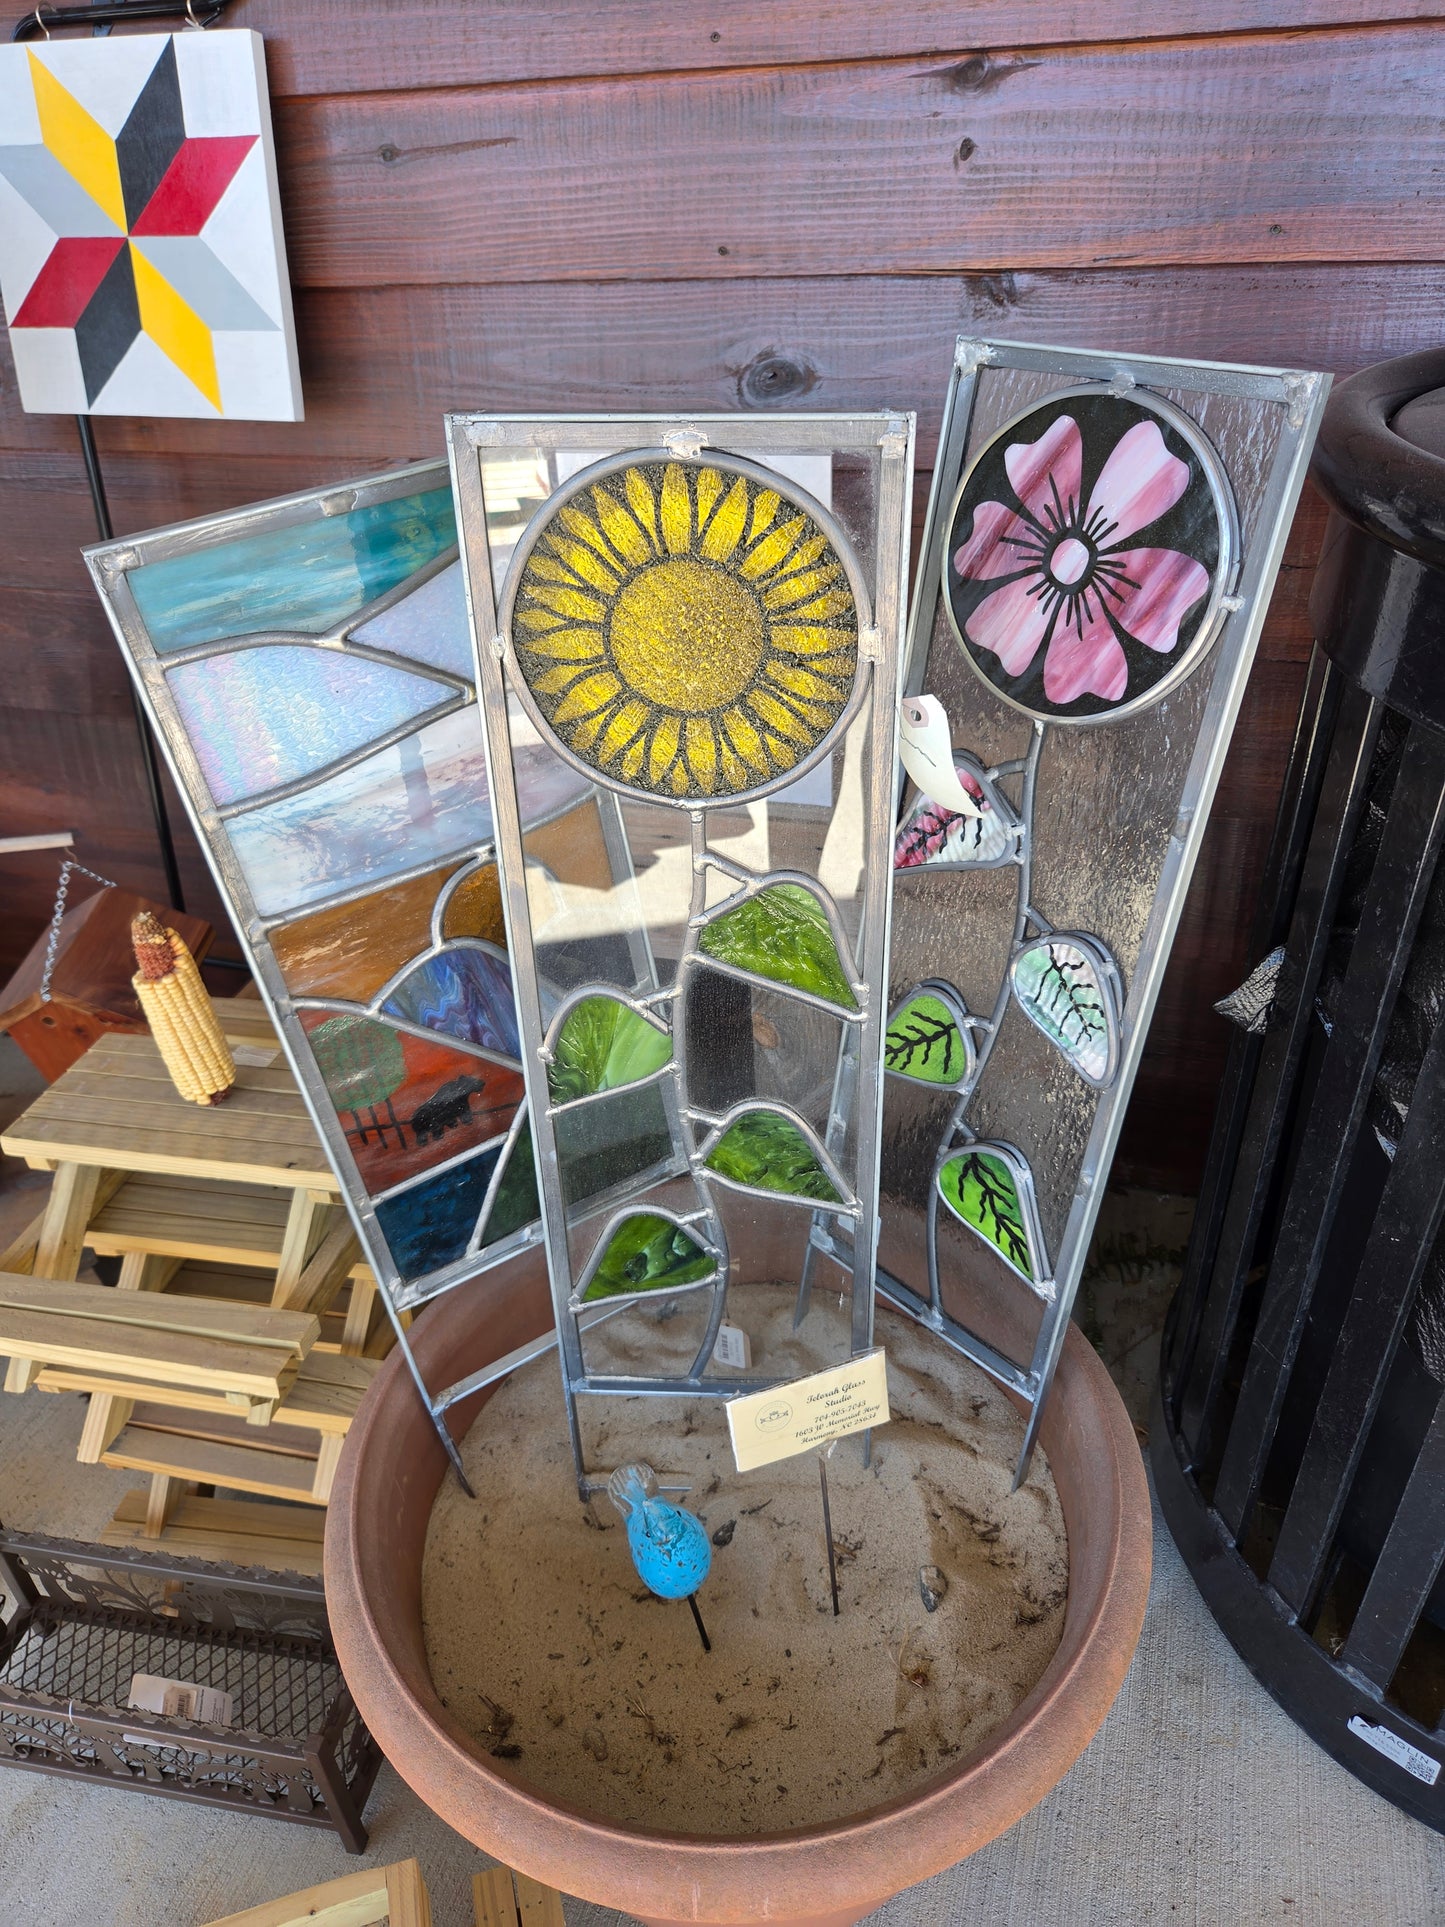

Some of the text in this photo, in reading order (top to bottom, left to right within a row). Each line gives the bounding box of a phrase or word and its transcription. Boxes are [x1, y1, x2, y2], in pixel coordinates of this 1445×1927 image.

[841, 1380, 866, 1393] Glass
[825, 1395, 852, 1408] Studio
[826, 1411, 861, 1428] Memorial
[863, 1404, 880, 1415] Hwy
[801, 1430, 838, 1444] Harmony,
[840, 1422, 853, 1431] NC
[1376, 1726, 1430, 1765] MAGLIN
